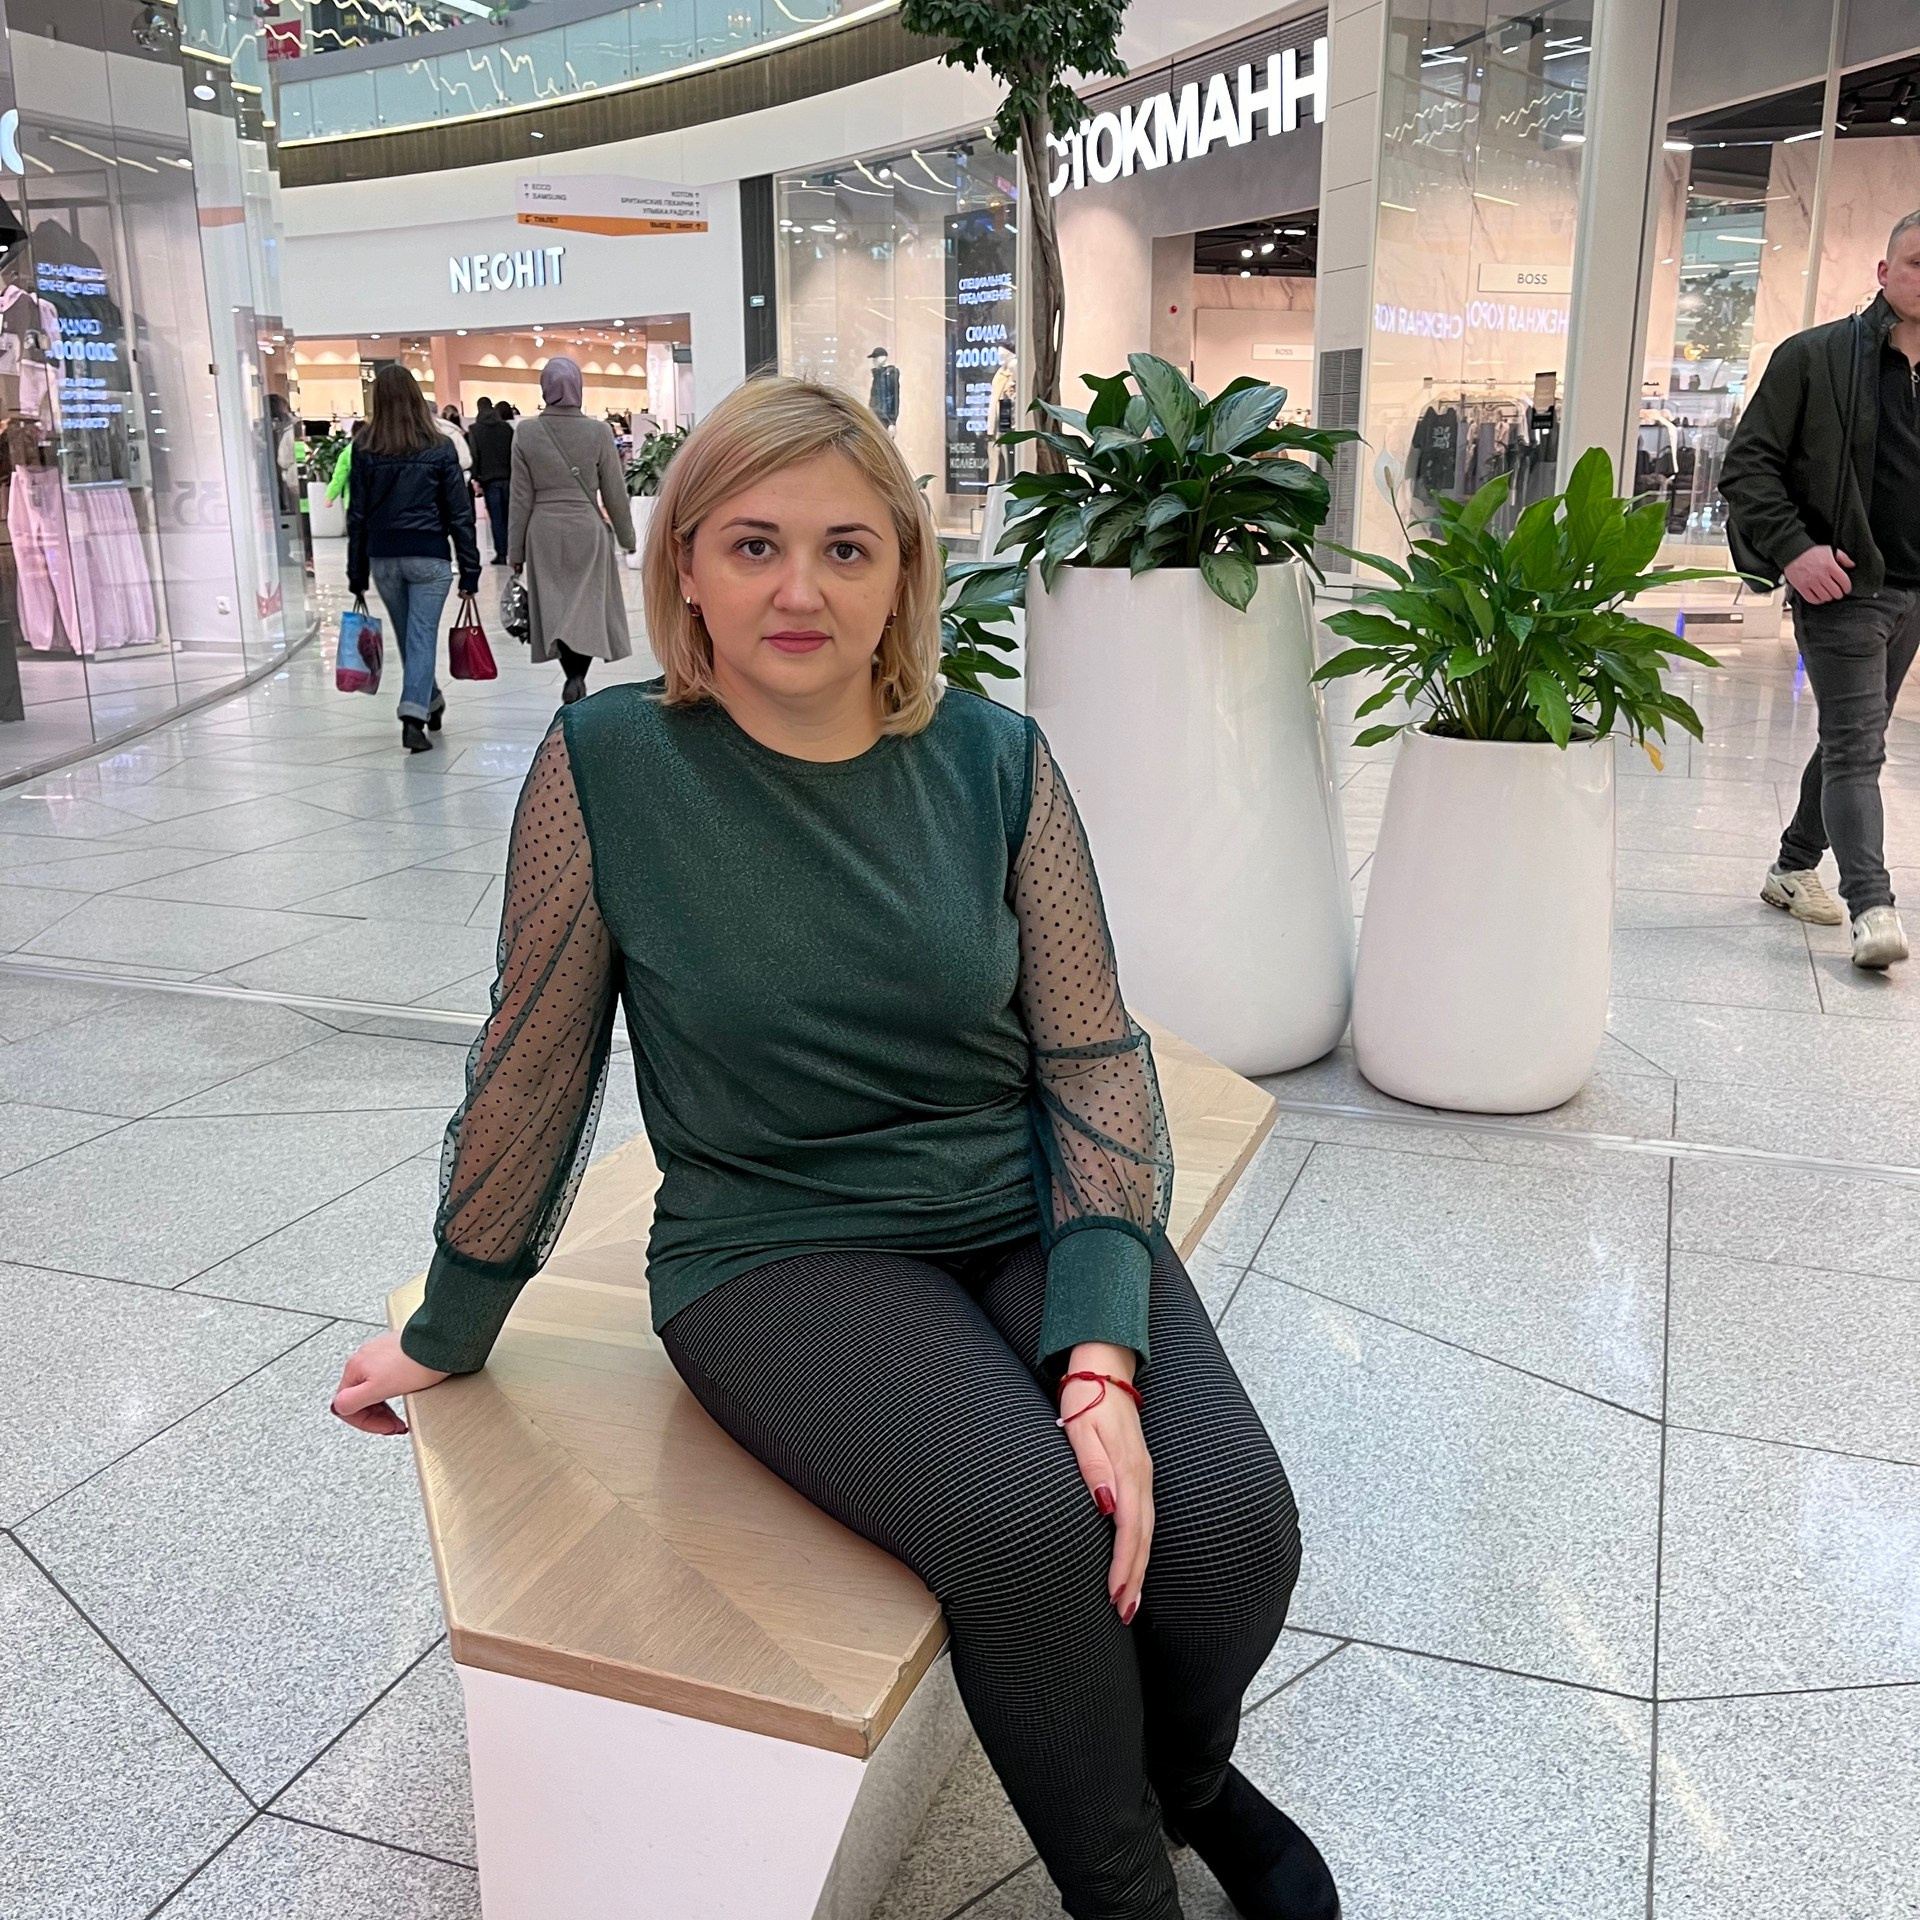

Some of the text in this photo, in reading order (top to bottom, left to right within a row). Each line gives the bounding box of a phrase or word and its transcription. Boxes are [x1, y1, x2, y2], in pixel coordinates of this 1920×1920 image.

[1047, 37, 1328, 198] СТОКМАНН
[532, 193, 567, 201] SAMSUNG
[449, 246, 565, 294] NEOHIT
[1517, 273, 1548, 285] BOSS
[965, 323, 1008, 343] СКИДКА
[955, 347, 980, 368] 200
[949, 457, 990, 471] КОЛЛЕКЦИ
